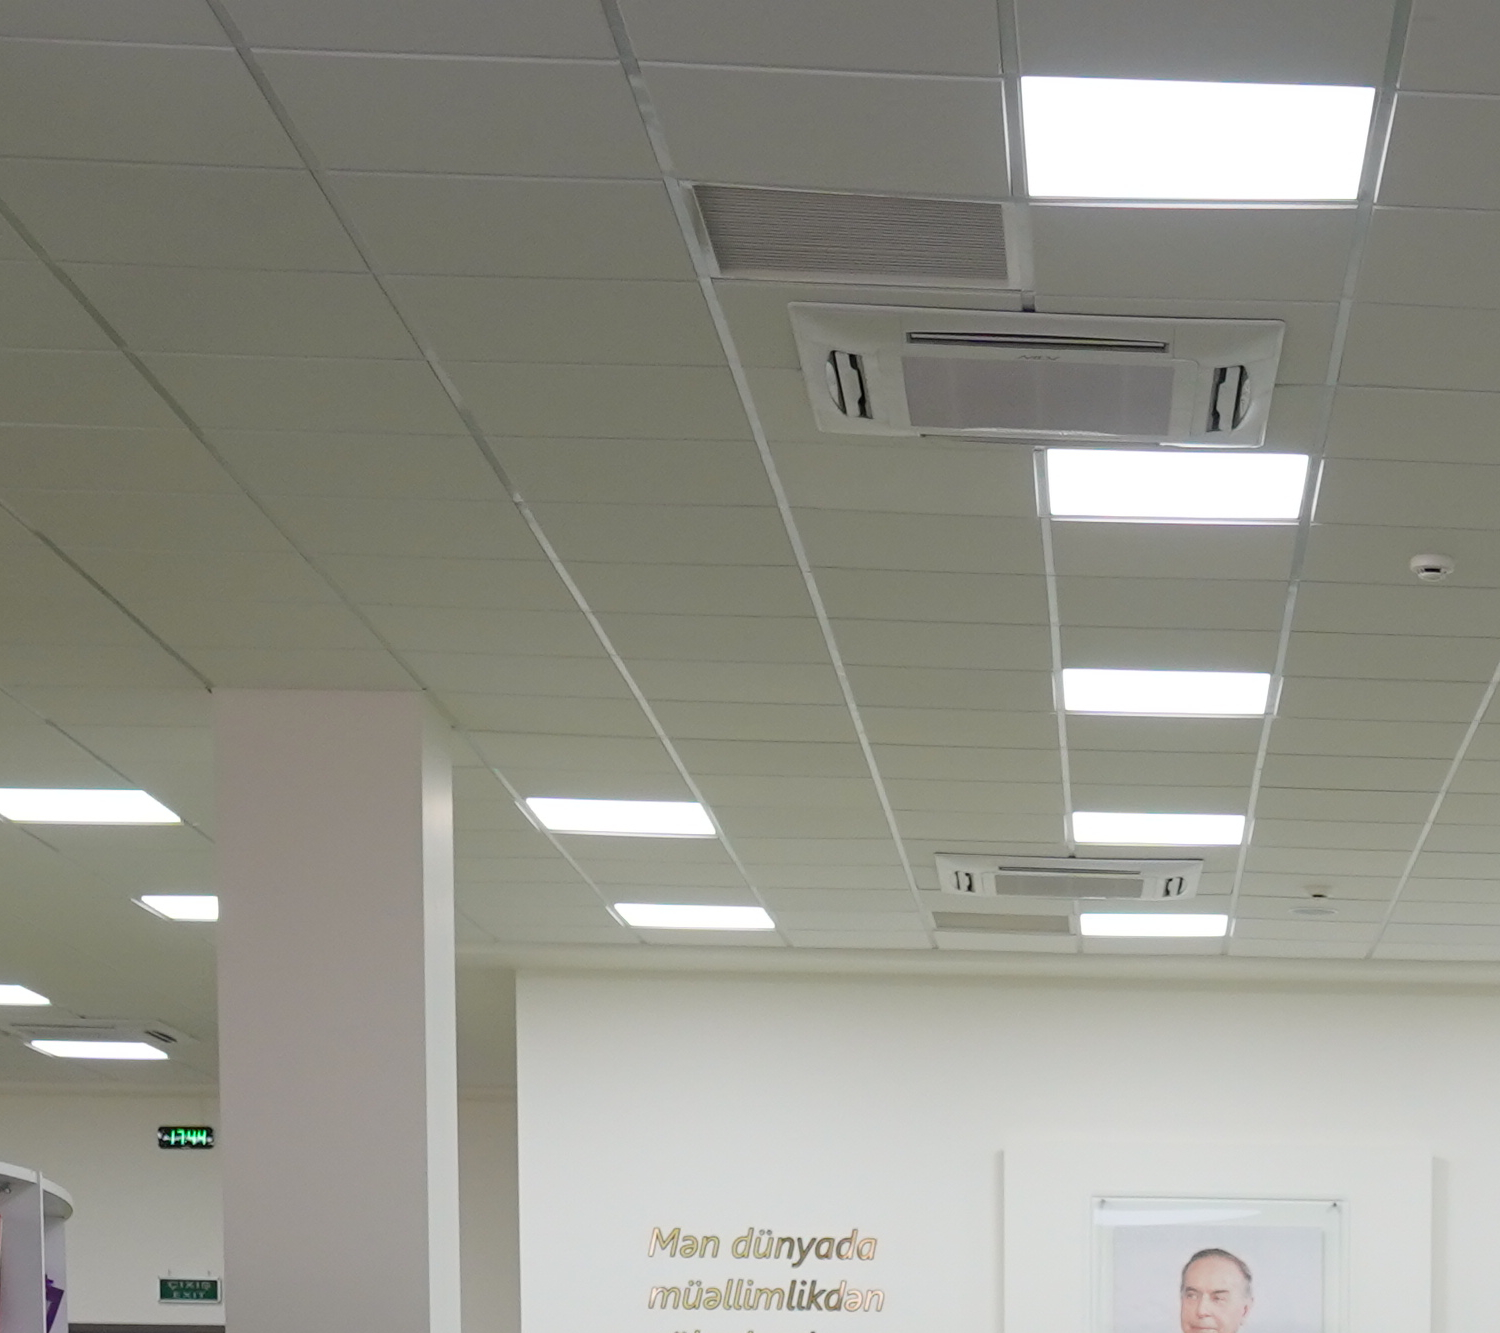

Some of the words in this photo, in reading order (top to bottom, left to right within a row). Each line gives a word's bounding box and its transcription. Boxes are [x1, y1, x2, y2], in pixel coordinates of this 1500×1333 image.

[648, 1227, 720, 1258] Mən
[731, 1226, 878, 1268] dünyada
[172, 1291, 206, 1299] EXIT
[647, 1278, 886, 1313] müəllimlikdən
